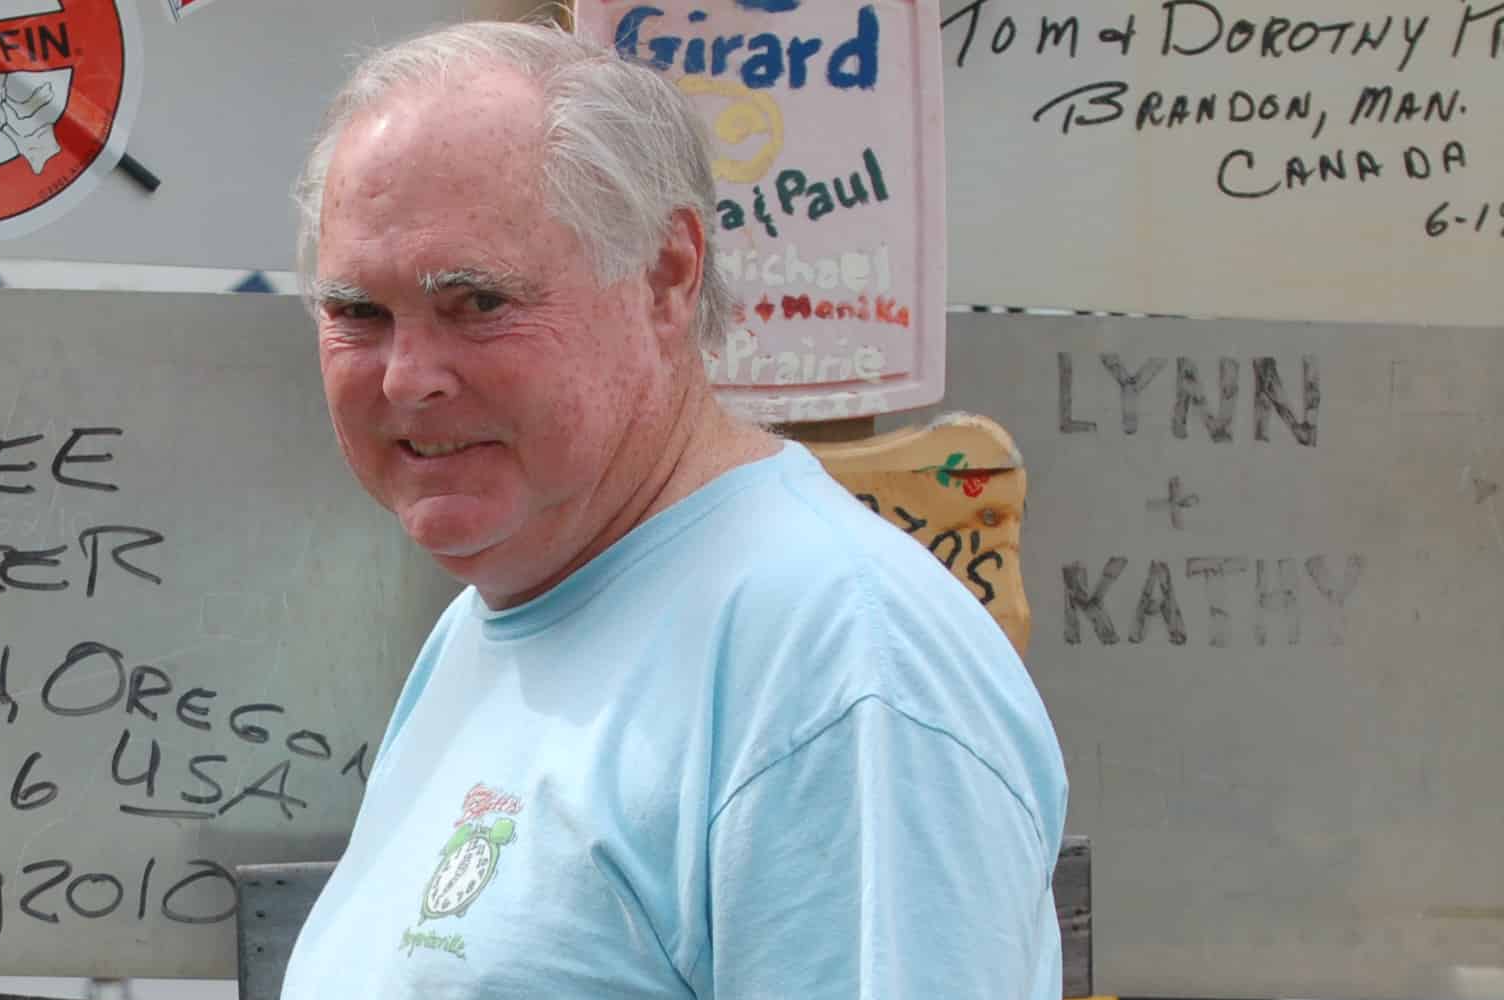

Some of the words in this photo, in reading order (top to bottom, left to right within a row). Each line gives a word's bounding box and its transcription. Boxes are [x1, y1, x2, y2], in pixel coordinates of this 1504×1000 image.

[615, 5, 880, 90] Girard
[941, 0, 1079, 67] TOM
[1163, 2, 1429, 71] DOROTHY
[1034, 81, 1326, 138] BRANDON,
[1351, 85, 1467, 125] MAN.
[774, 148, 889, 221] Paul
[1218, 141, 1466, 198] CANADA
[727, 328, 886, 384] Prairie
[1057, 351, 1322, 447] LYNN
[1060, 553, 1368, 648] KATHY
[112, 729, 307, 821] USA
[20, 857, 240, 924] 2010
